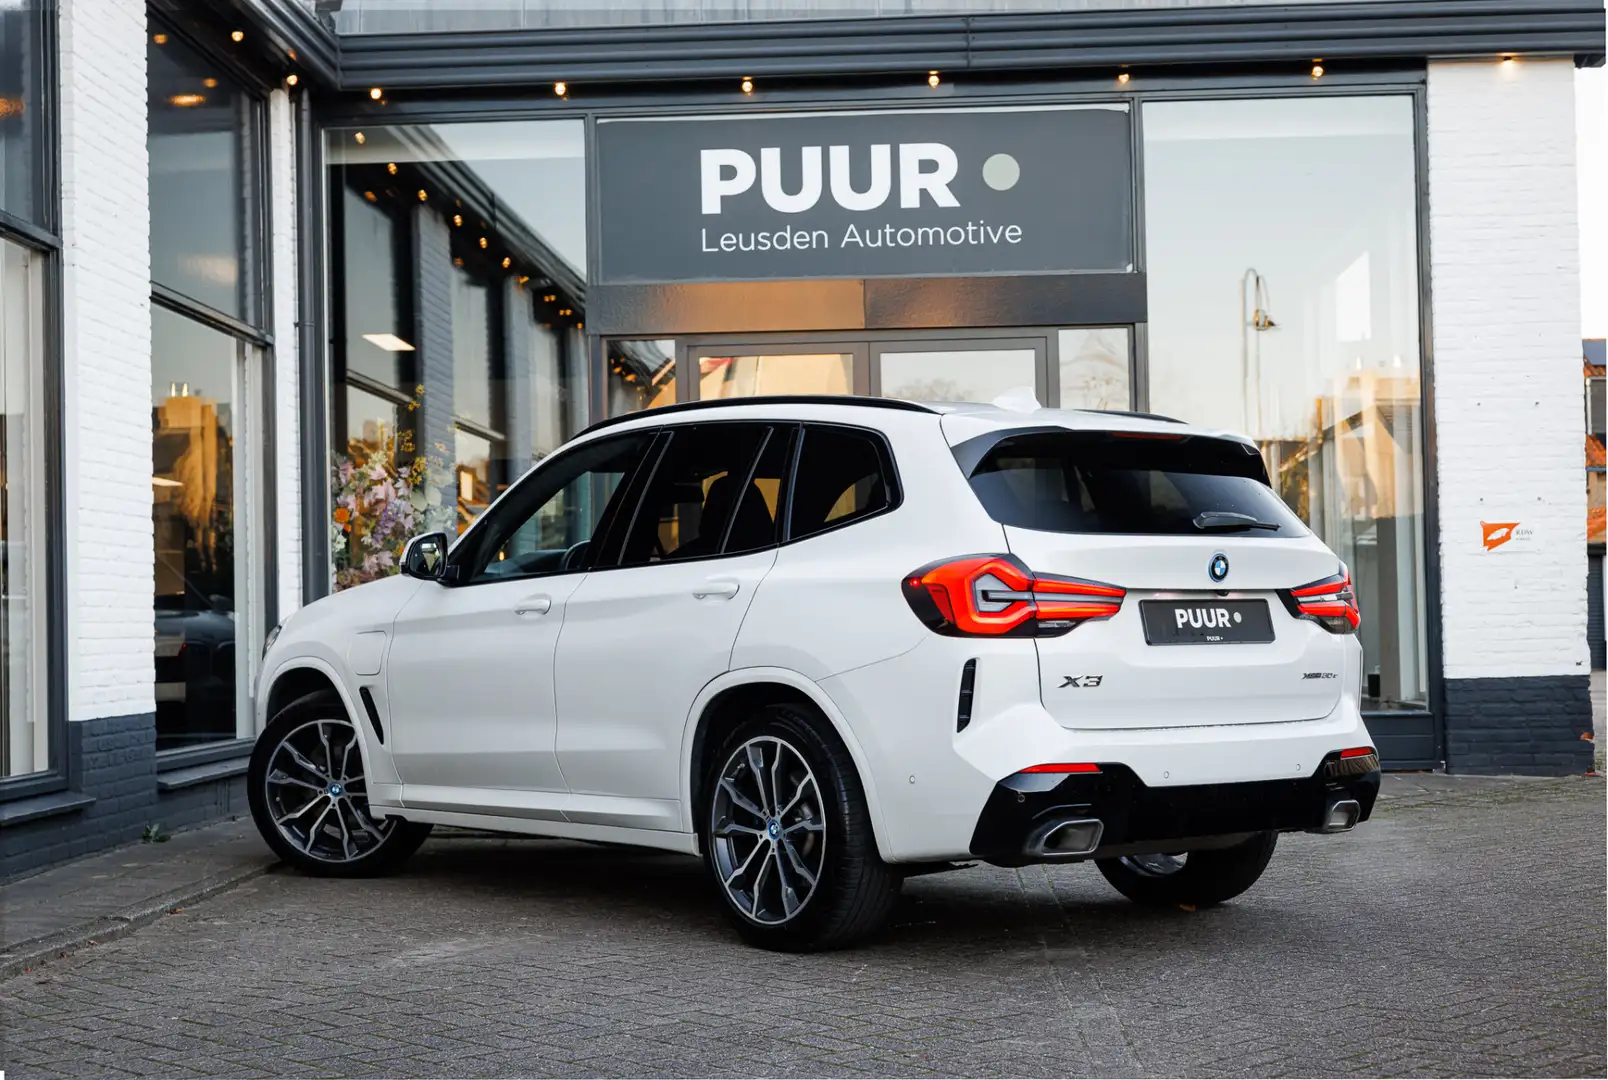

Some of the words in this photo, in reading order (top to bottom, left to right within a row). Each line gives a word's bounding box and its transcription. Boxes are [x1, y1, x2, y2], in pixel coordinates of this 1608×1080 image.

[700, 142, 961, 215] PUUR
[702, 225, 829, 252] Leusden
[840, 220, 1023, 249] Automotive
[1174, 608, 1232, 629] PUUR
[1056, 675, 1103, 688] X3
